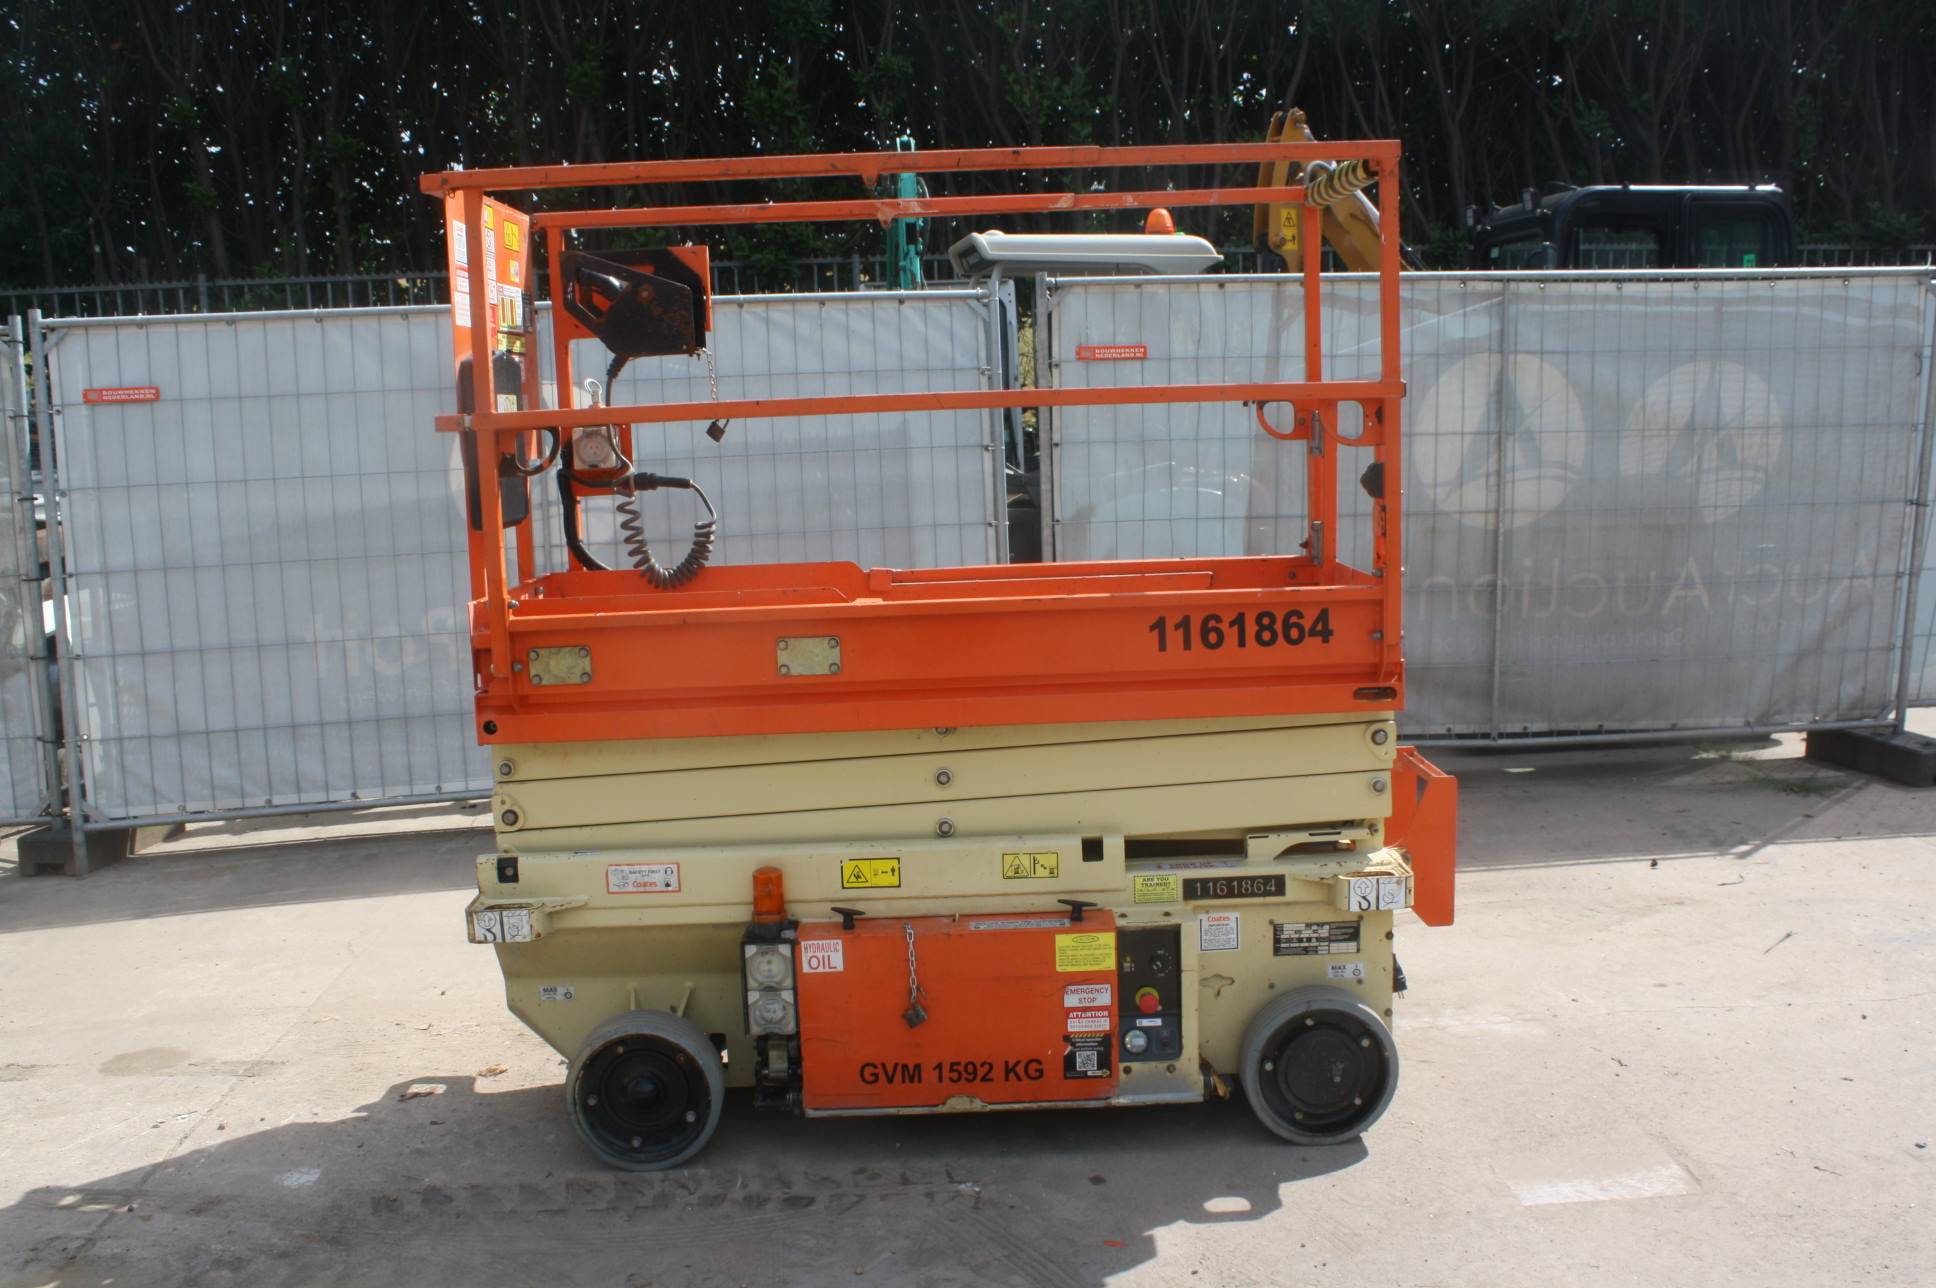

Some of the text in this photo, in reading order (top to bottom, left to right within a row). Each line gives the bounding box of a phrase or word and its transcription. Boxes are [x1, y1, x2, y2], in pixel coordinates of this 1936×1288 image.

[1149, 608, 1334, 652] 1161864
[1195, 878, 1276, 896] 1161864
[803, 942, 840, 953] HYDRAULIC
[808, 955, 837, 970] OIL
[1065, 986, 1109, 996] EMERGENCY
[859, 1059, 1044, 1084] GVM 1592 KG
